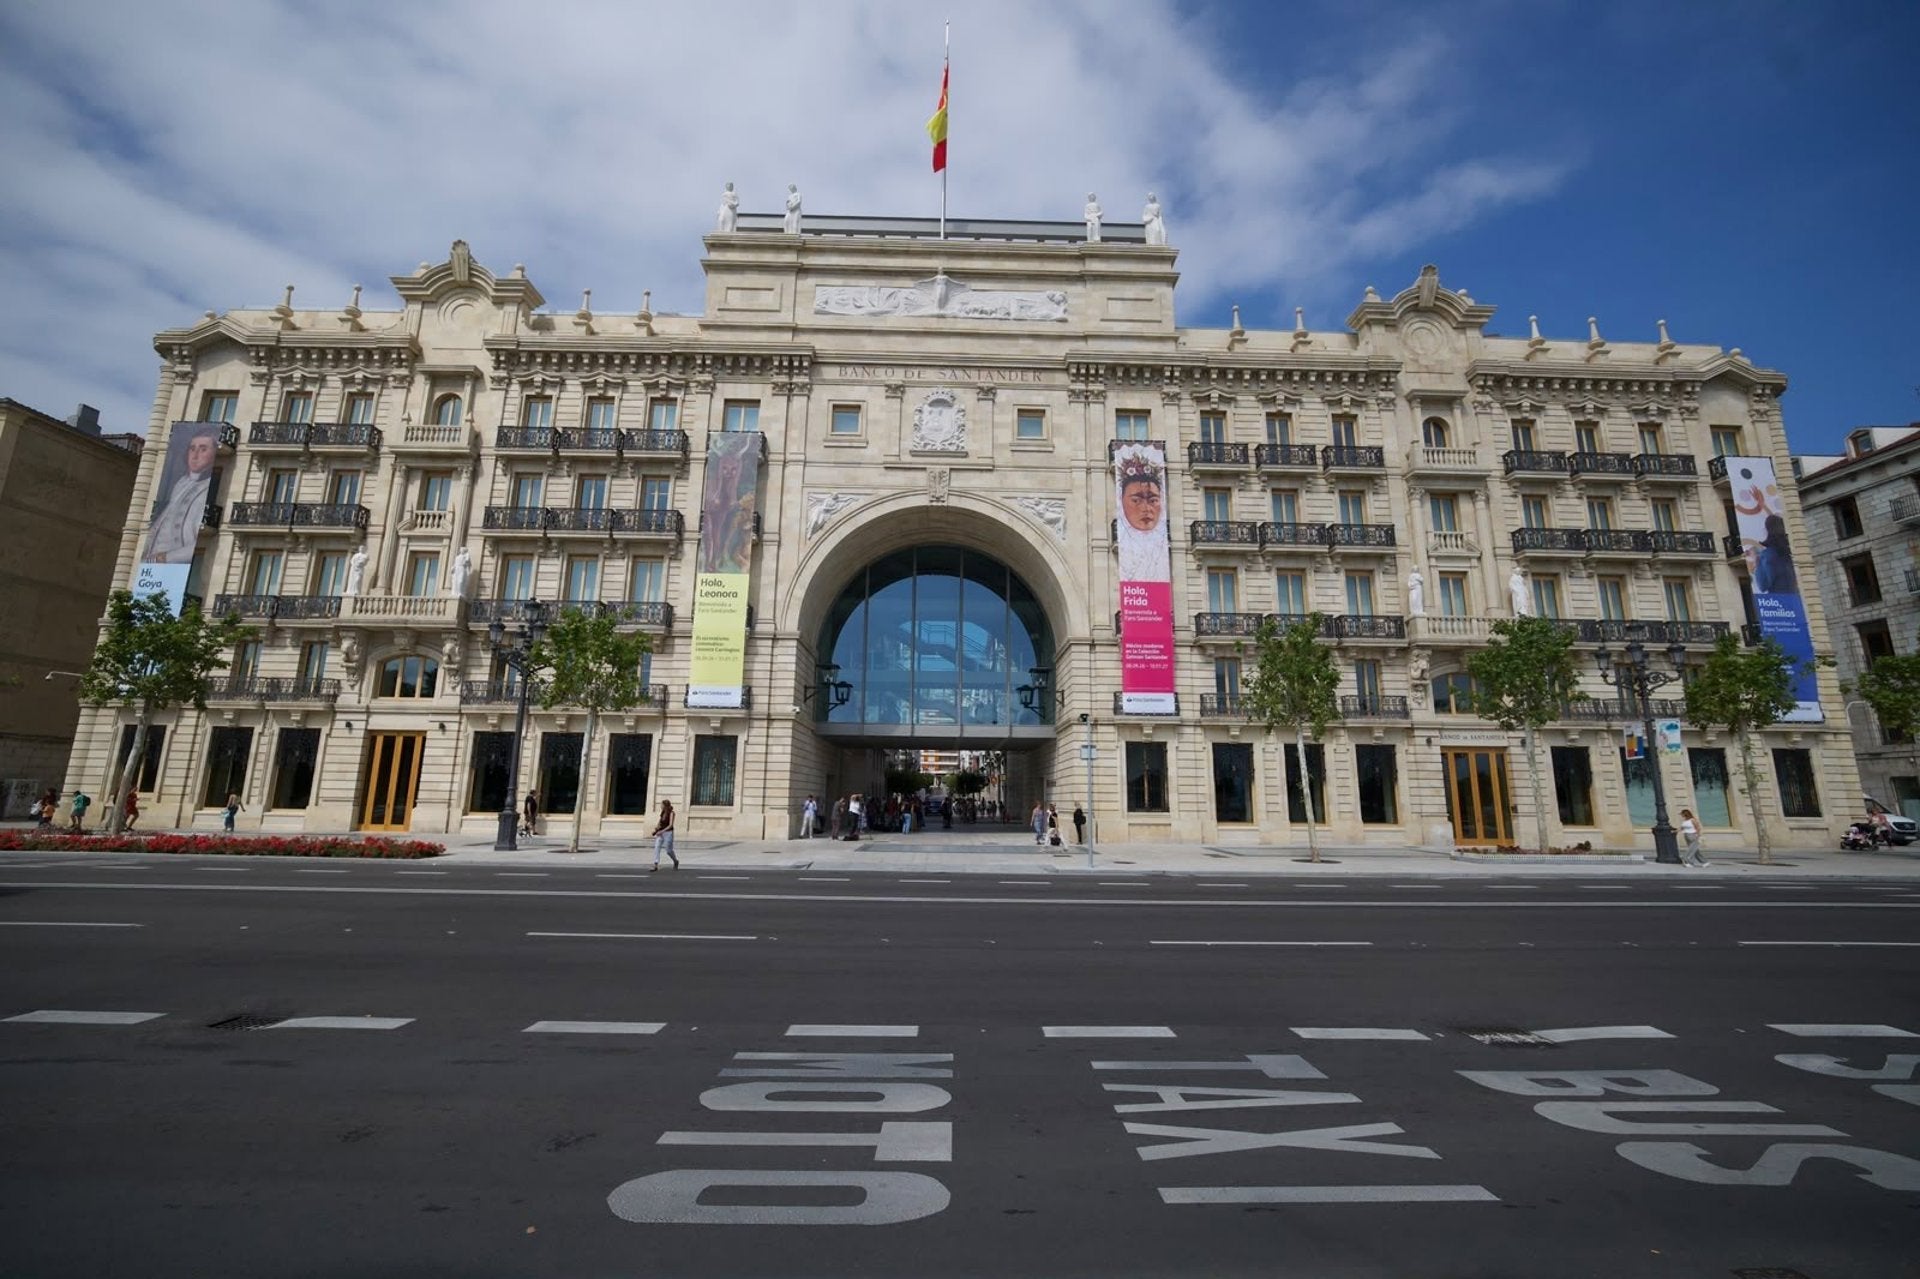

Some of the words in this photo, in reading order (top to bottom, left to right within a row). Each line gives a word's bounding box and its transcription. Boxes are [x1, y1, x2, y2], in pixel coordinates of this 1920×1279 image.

[839, 365, 895, 378] BANCO
[904, 366, 925, 379] DE
[939, 367, 1043, 382] SANTANDER
[141, 568, 153, 578] Hi,
[138, 579, 162, 590] Goya
[700, 578, 725, 588] Hola,
[700, 589, 738, 599] Leonora
[1123, 586, 1148, 596] Hola,
[1123, 596, 1148, 606] Frida
[1757, 598, 1782, 608] Hola,
[1760, 608, 1796, 618] familias
[1091, 1054, 1501, 1204] TAXI
[1454, 1069, 1920, 1191] BUS
[606, 1052, 953, 1225] MOTO
